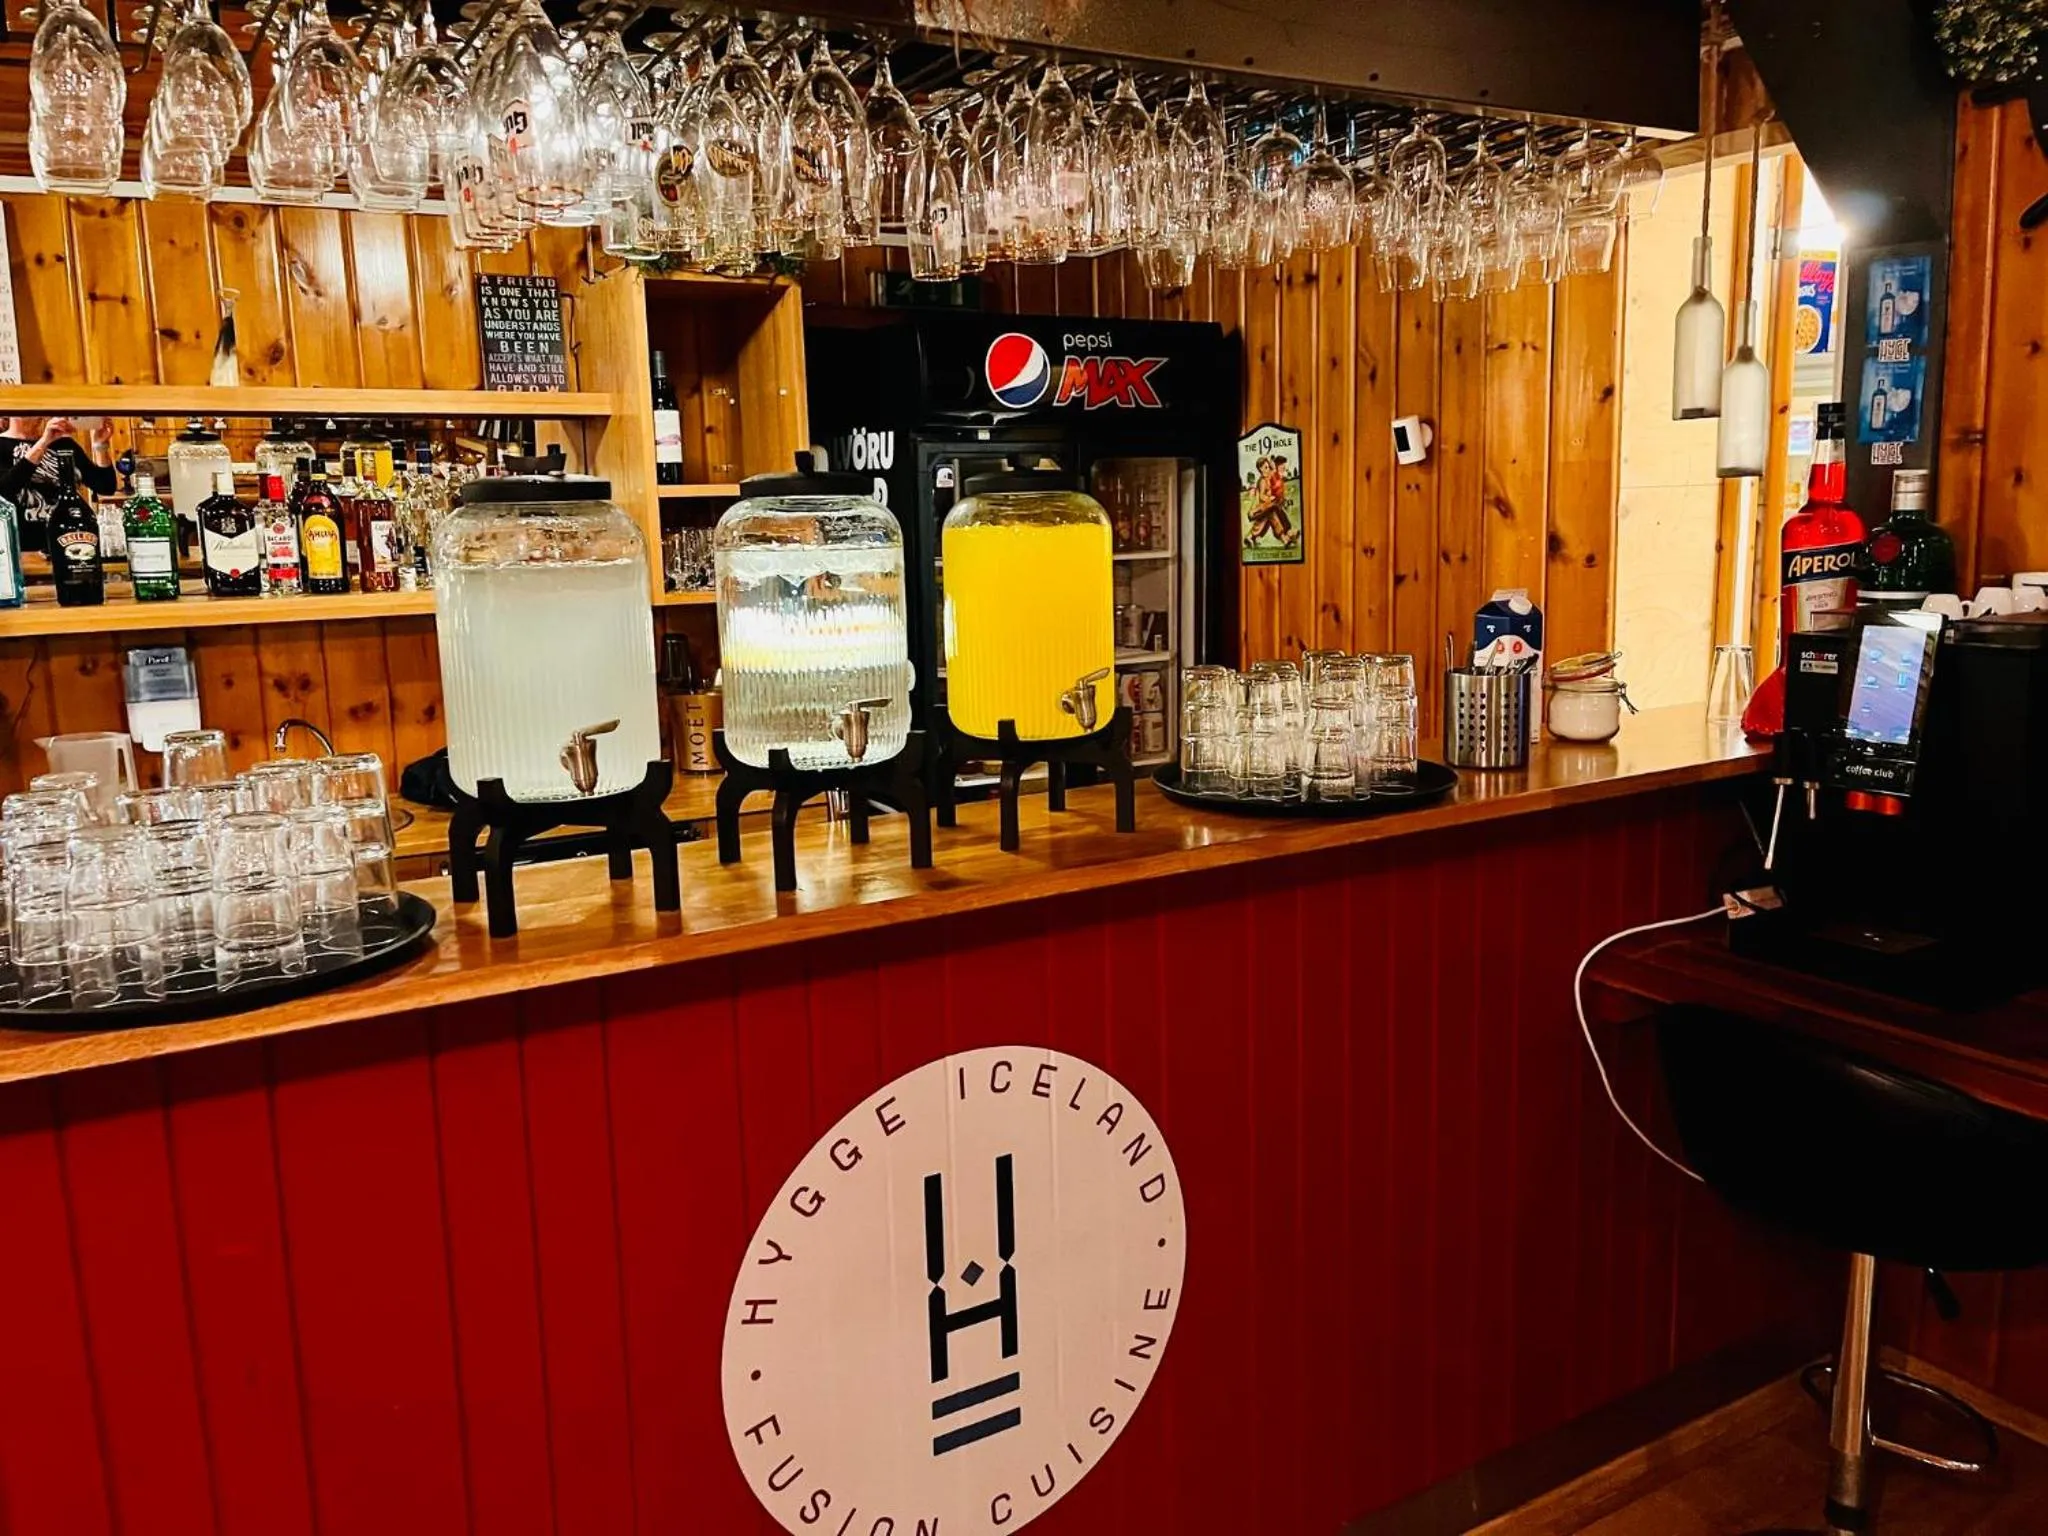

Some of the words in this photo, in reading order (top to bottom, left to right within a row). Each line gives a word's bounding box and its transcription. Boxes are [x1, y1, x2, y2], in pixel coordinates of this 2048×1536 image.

[481, 275, 489, 284] A
[496, 276, 556, 287] FRIEND
[481, 286, 493, 296] IS
[499, 287, 521, 297] ONE
[527, 288, 557, 298] THAT
[481, 297, 528, 308] KNOWS
[533, 299, 558, 308] YOU
[484, 307, 501, 319] AS
[506, 308, 531, 320] YOU
[535, 309, 560, 321] ARE
[484, 320, 560, 331] UNDERSTANDS
[486, 331, 516, 340] WHERE
[517, 331, 535, 340] YOU
[537, 332, 561, 341] HAVE
[1063, 332, 1113, 351] pepsi
[500, 341, 549, 354] BEEN
[489, 363, 515, 373] HAVE
[518, 363, 537, 373] AND
[539, 363, 565, 374] STILL
[490, 373, 529, 384] ALLOWS
[531, 373, 550, 384] YOU
[552, 374, 565, 385] TO
[1053, 355, 1168, 411] MAX
[1788, 552, 1858, 578] APEROL
[1845, 765, 1872, 776] coffee
[1874, 767, 1895, 779] club
[741, 1097, 906, 1325] HYGGE
[959, 1060, 1167, 1204] ICELAND
[990, 1288, 1171, 1524] CUISINE
